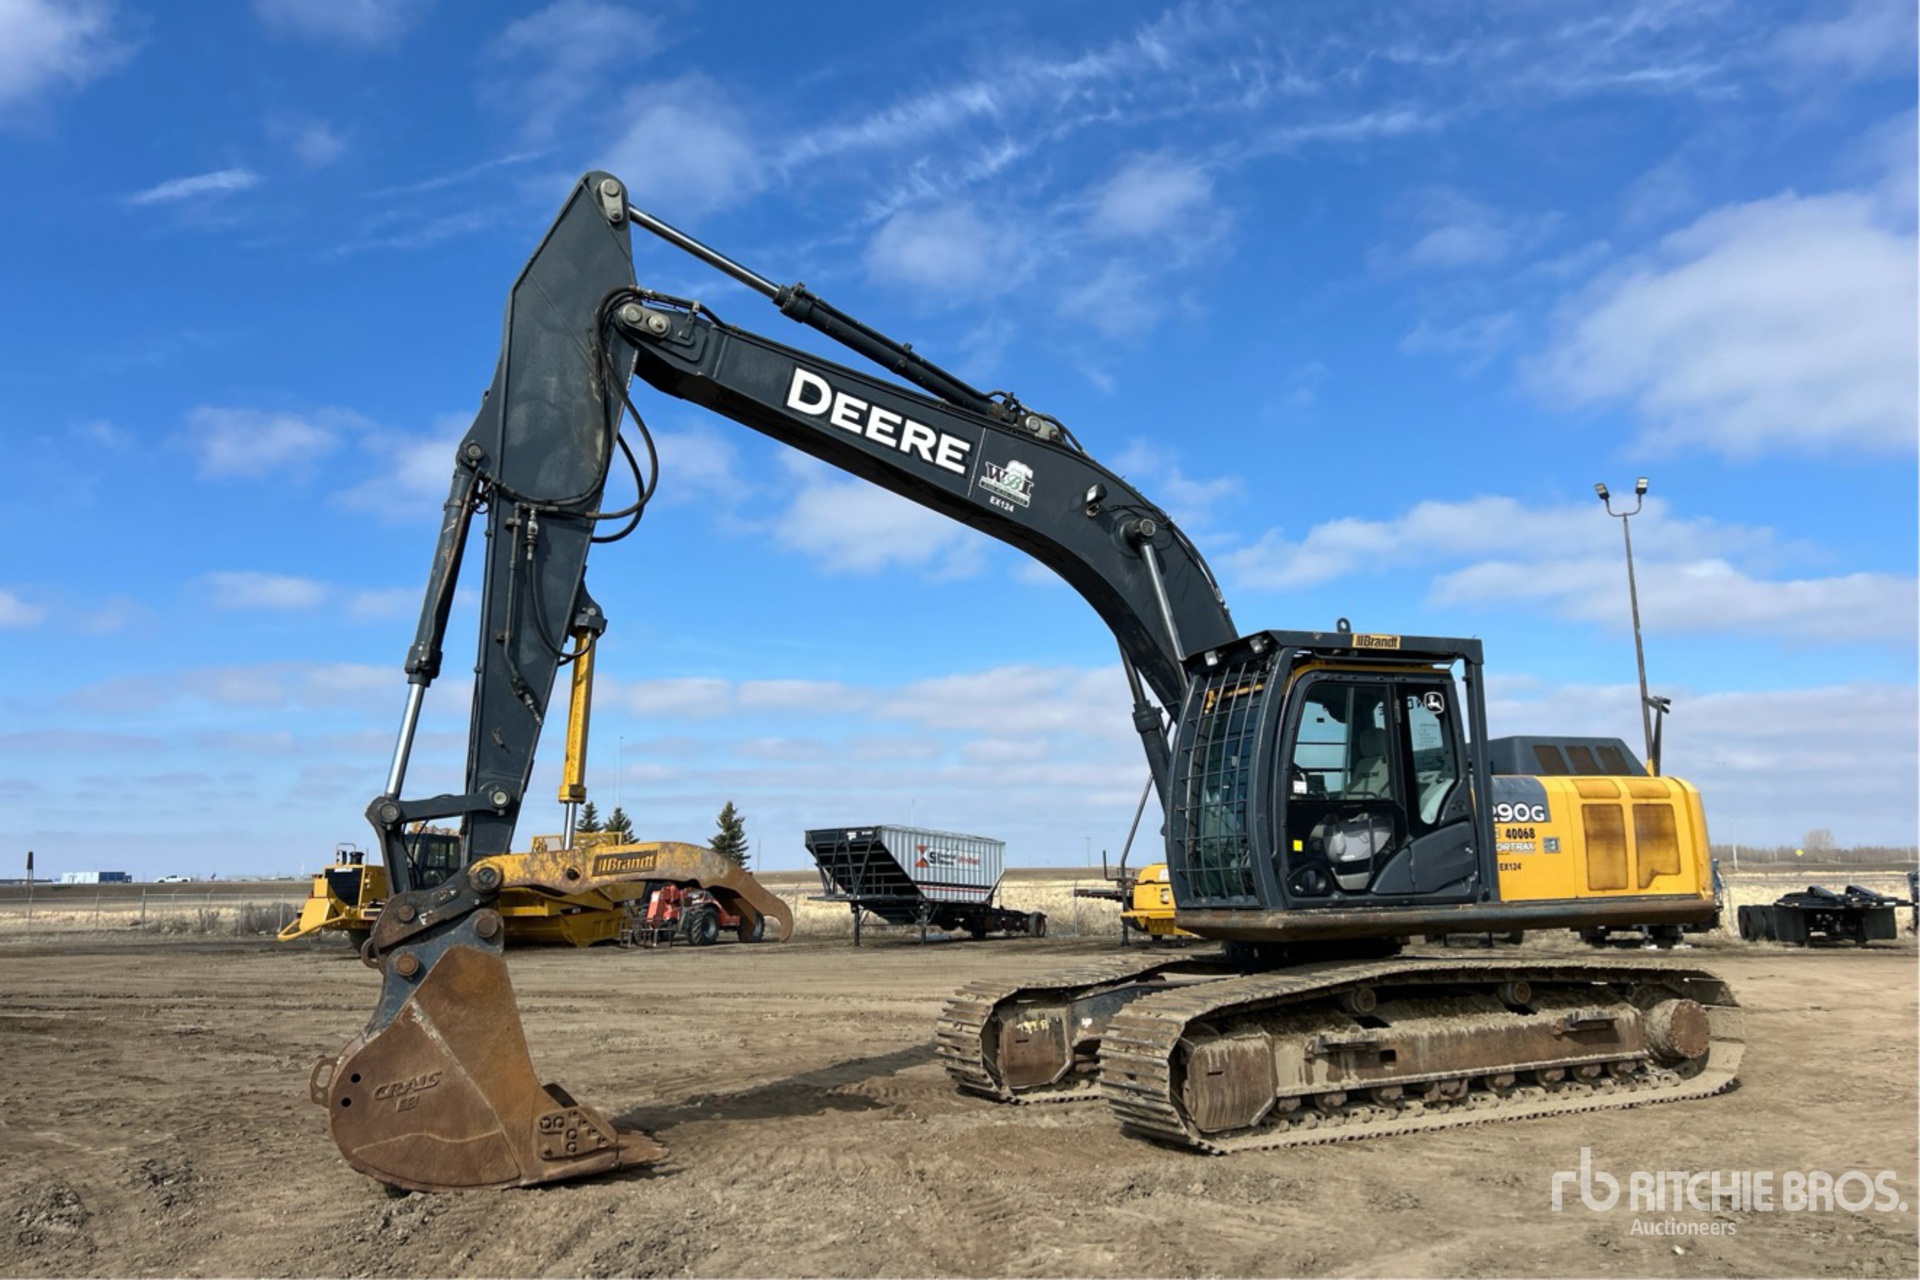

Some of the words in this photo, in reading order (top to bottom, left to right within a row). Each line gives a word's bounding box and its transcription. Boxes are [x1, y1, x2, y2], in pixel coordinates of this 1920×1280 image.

[786, 367, 971, 475] DEERE
[989, 495, 1015, 512] EX124
[1363, 633, 1399, 649] Brandt
[1505, 828, 1536, 840] 40068
[1496, 842, 1536, 851] ORTRAX
[607, 855, 655, 871] Brandt
[1500, 862, 1522, 871] EX124
